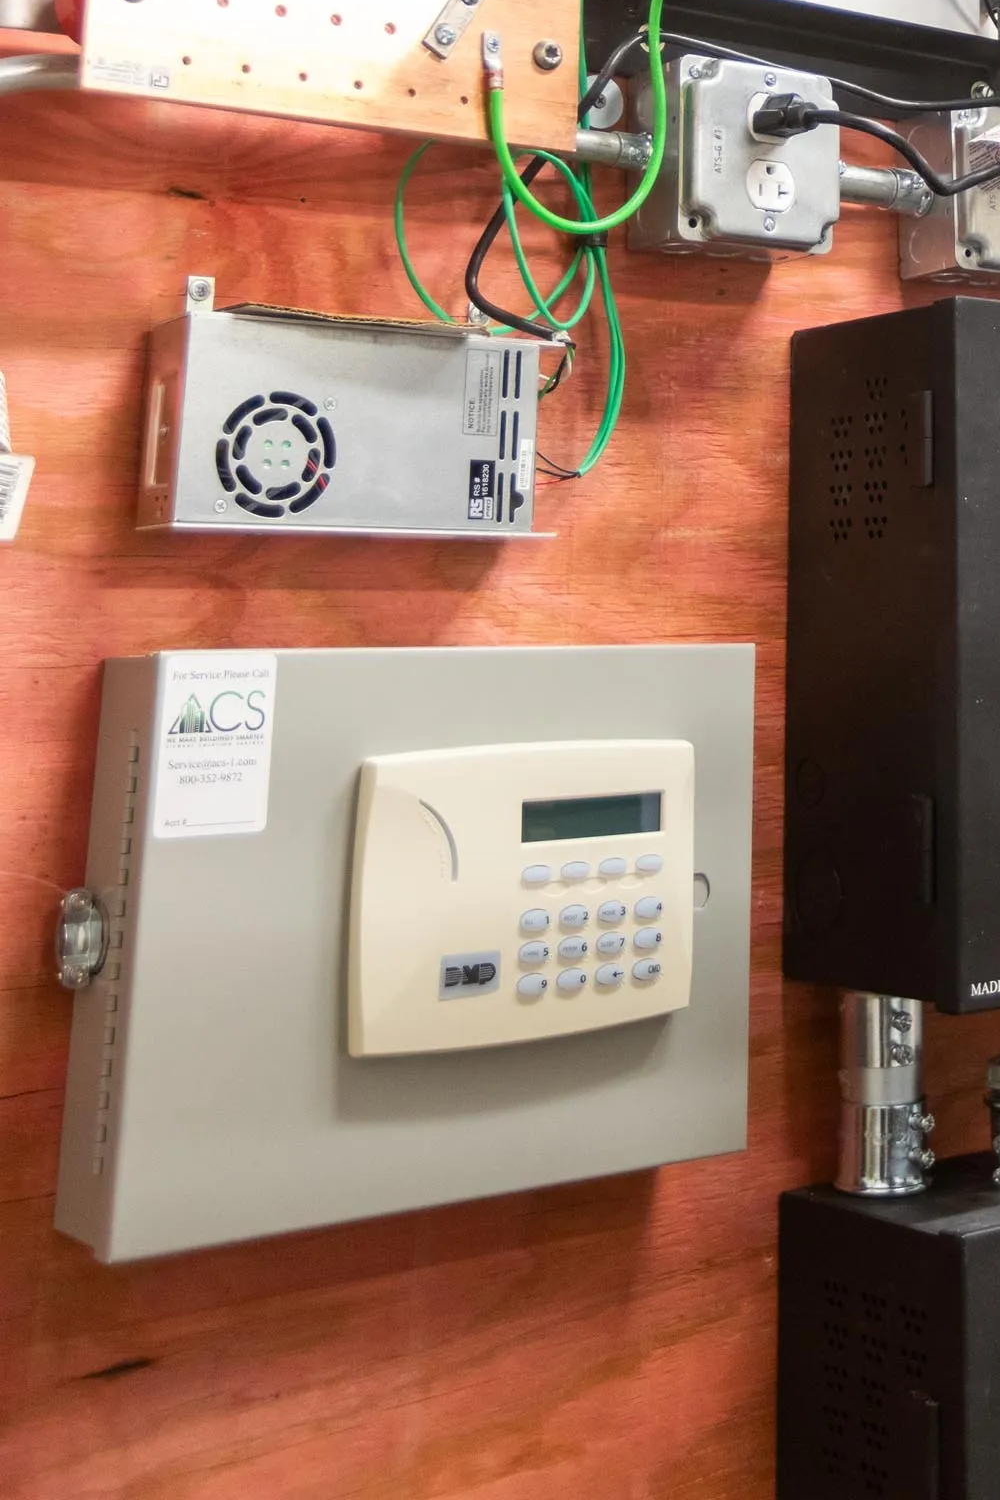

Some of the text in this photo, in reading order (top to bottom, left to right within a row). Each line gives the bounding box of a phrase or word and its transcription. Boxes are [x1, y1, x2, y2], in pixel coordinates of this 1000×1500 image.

[482, 464, 490, 496] 1618230
[474, 484, 481, 497] RS
[469, 498, 484, 518] RS
[173, 669, 270, 681] For Service Please Call
[168, 690, 265, 735] ACS
[179, 772, 243, 785] 800-352-9872
[620, 906, 626, 916] 3
[656, 902, 662, 911] 4
[545, 915, 550, 924] 1
[582, 911, 589, 920] 2
[656, 932, 661, 942] 8
[581, 942, 587, 952] 6
[620, 938, 625, 947] 7
[543, 947, 549, 956] 5
[647, 964, 661, 974] CMD
[541, 979, 548, 988] 9
[580, 974, 586, 983] 0
